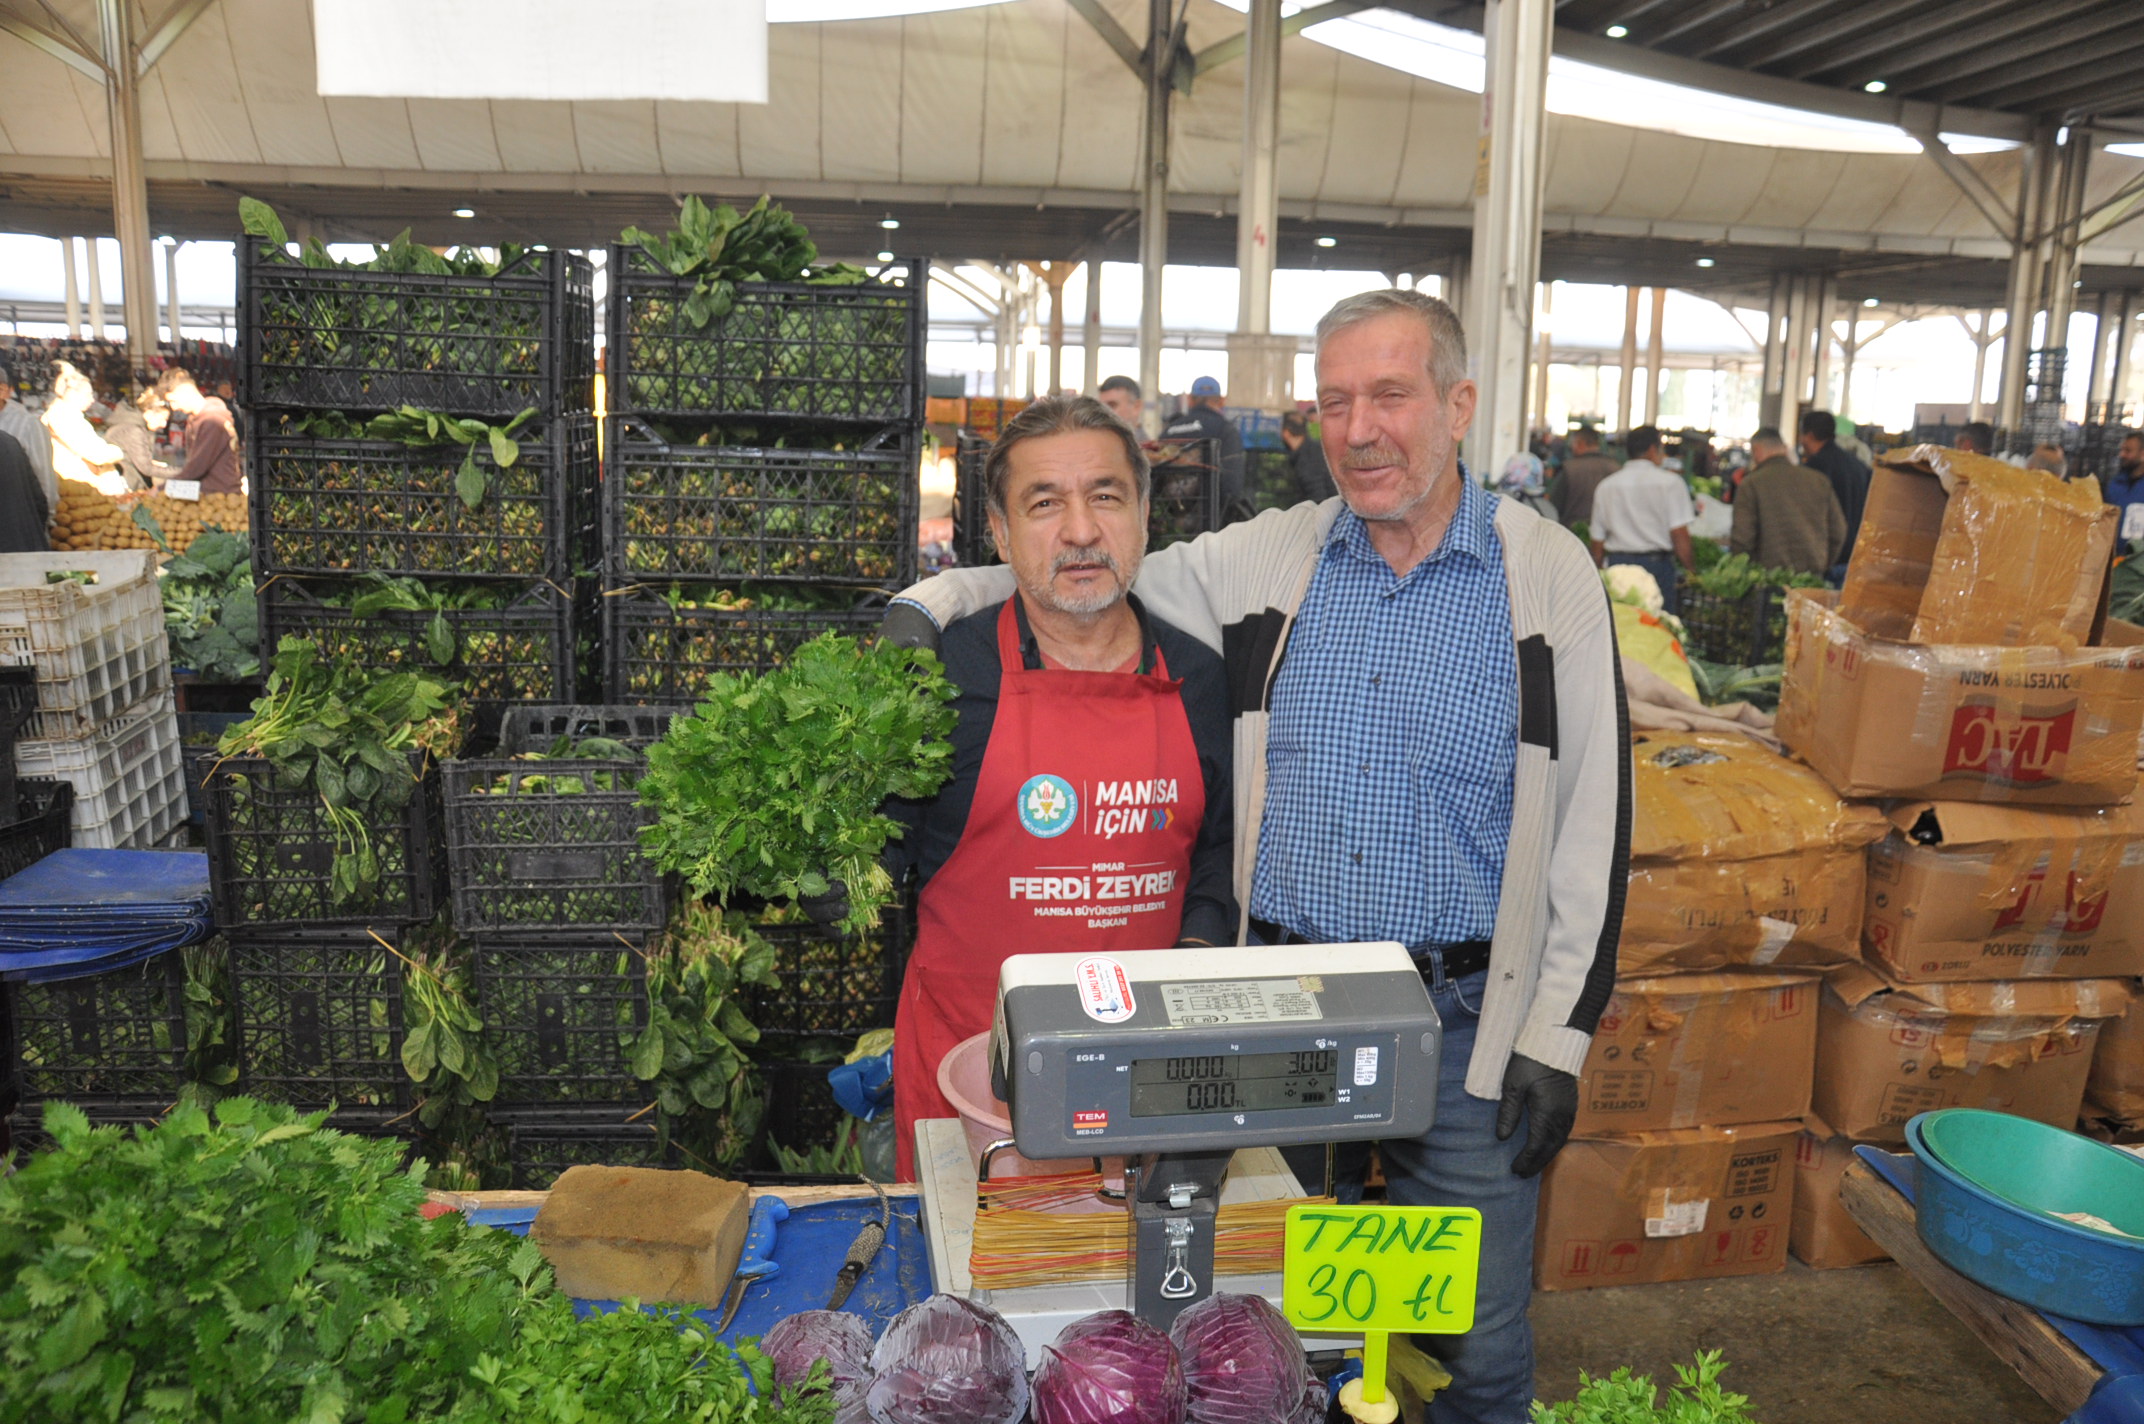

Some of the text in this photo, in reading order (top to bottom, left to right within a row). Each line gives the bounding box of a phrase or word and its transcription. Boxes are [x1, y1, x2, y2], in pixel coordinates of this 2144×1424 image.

[1960, 671, 1999, 687] YARN
[1095, 778, 1178, 806] MANİSA
[1094, 808, 1148, 839] İÇİN
[1009, 870, 1177, 900] FERDİ ZEYREK
[1982, 943, 2091, 957] POLYESTER YARN
[1076, 1054, 1105, 1062] EGE-B
[1288, 1050, 1329, 1074] 3.00
[1187, 1082, 1235, 1110] 0.00
[1076, 1113, 1106, 1121] TEM
[1732, 1152, 1778, 1168] KORTEKS
[1299, 1213, 1474, 1254] TANE
[1298, 1263, 1377, 1322] 30
